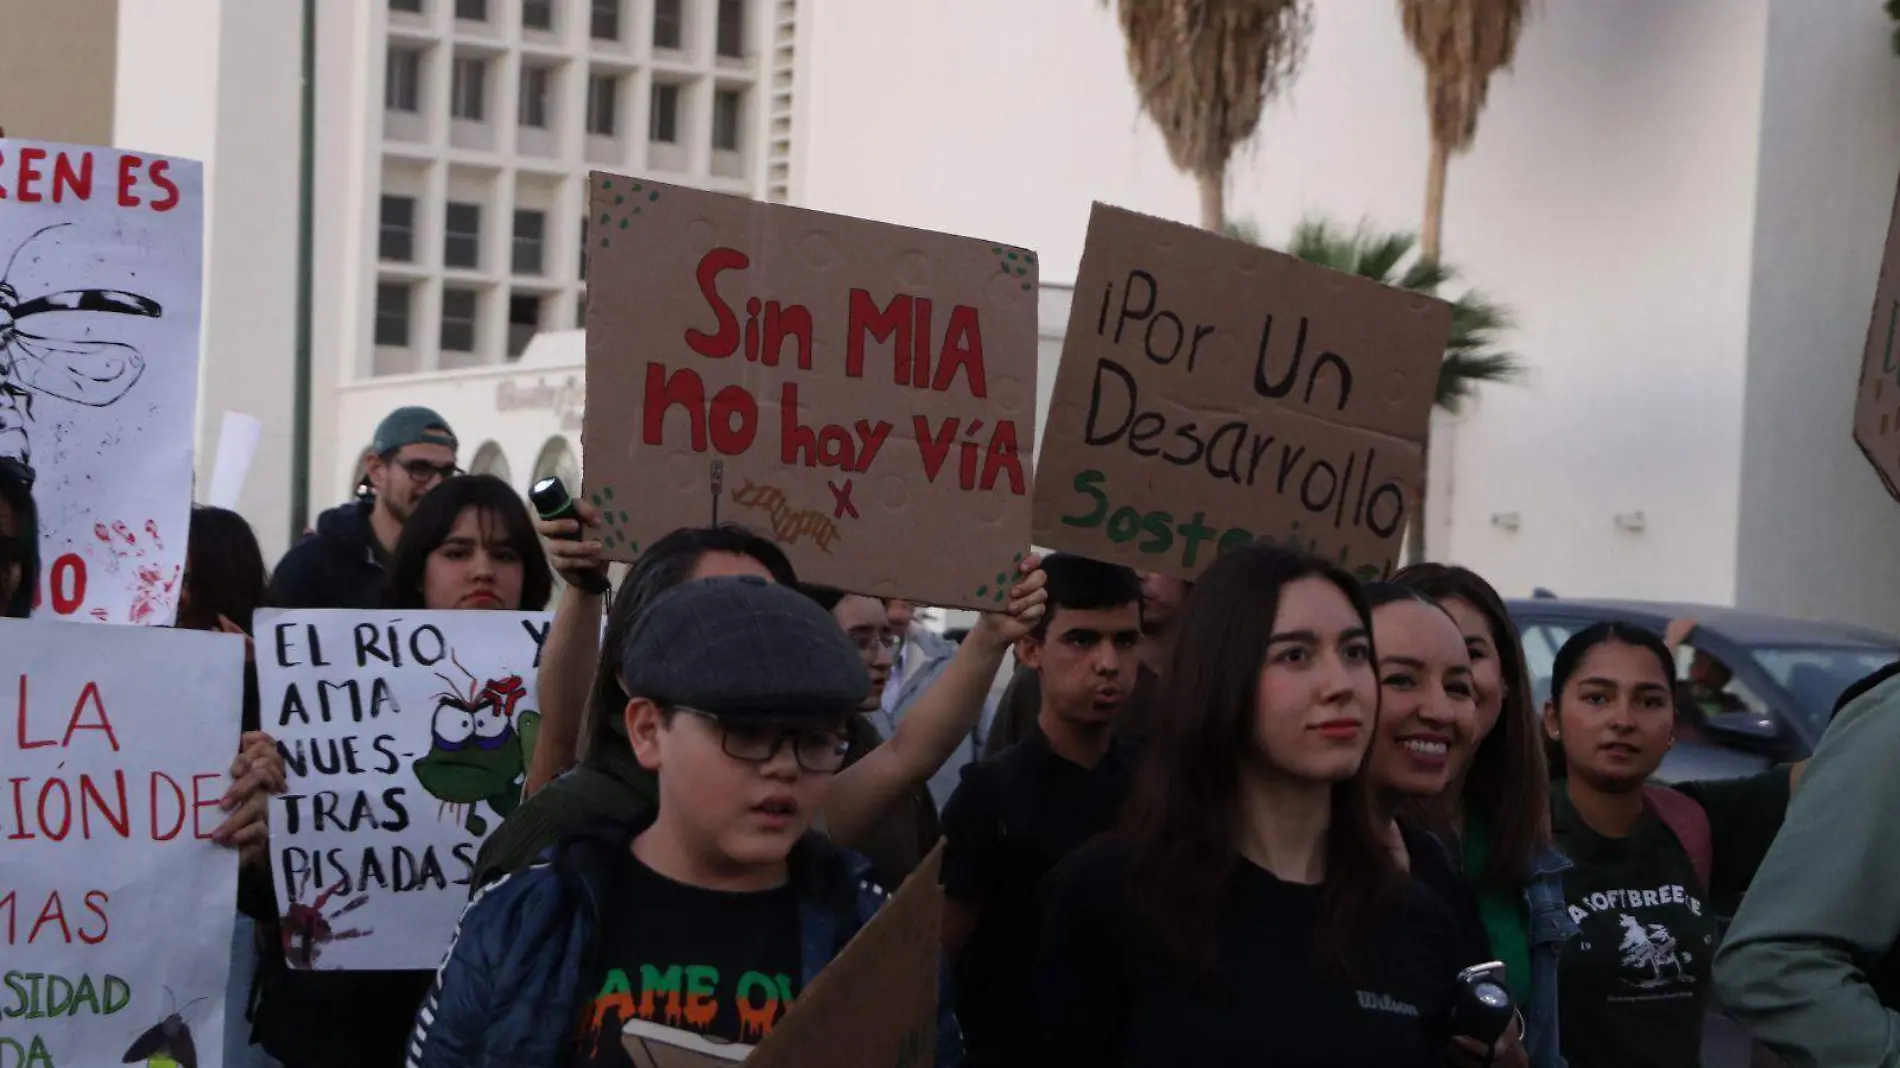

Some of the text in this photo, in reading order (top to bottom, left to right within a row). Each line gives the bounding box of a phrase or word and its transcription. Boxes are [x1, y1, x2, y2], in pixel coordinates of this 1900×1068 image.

[0, 147, 180, 212] EN ES
[685, 247, 987, 398] Sin MIA
[1254, 314, 1352, 411] Un
[643, 362, 758, 456] no
[781, 382, 893, 473] hay
[1085, 358, 1405, 539] Desarrollo
[275, 619, 550, 668] EL RÍO Y
[18, 674, 120, 751] LA
[279, 677, 400, 726] AMA
[276, 735, 414, 777] NUES-
[151, 771, 222, 841] DE
[277, 787, 409, 835] TRAS
[282, 843, 475, 901] PISADAS
[1567, 904, 1588, 924] A
